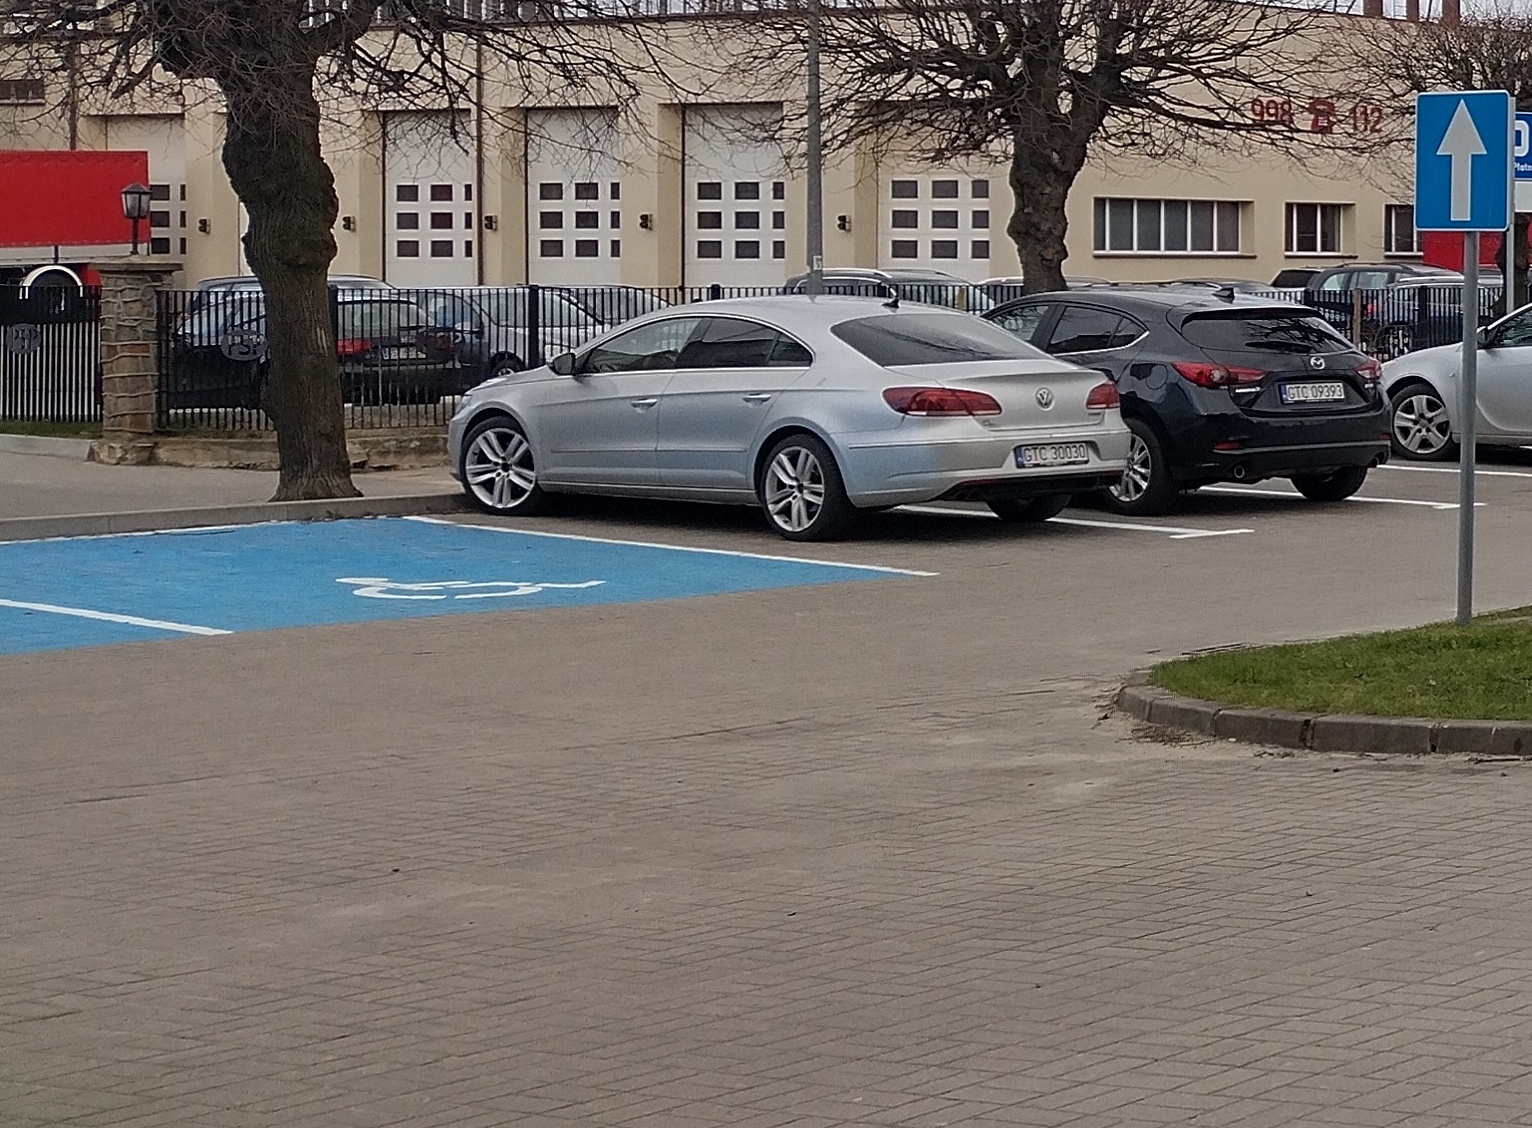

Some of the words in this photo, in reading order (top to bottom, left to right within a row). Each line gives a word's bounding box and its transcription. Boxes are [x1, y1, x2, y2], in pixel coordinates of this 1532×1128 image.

[1288, 386, 1309, 399] GTC
[1311, 384, 1342, 398] 09393
[1023, 446, 1047, 462] GTC
[1050, 444, 1086, 460] 30030
